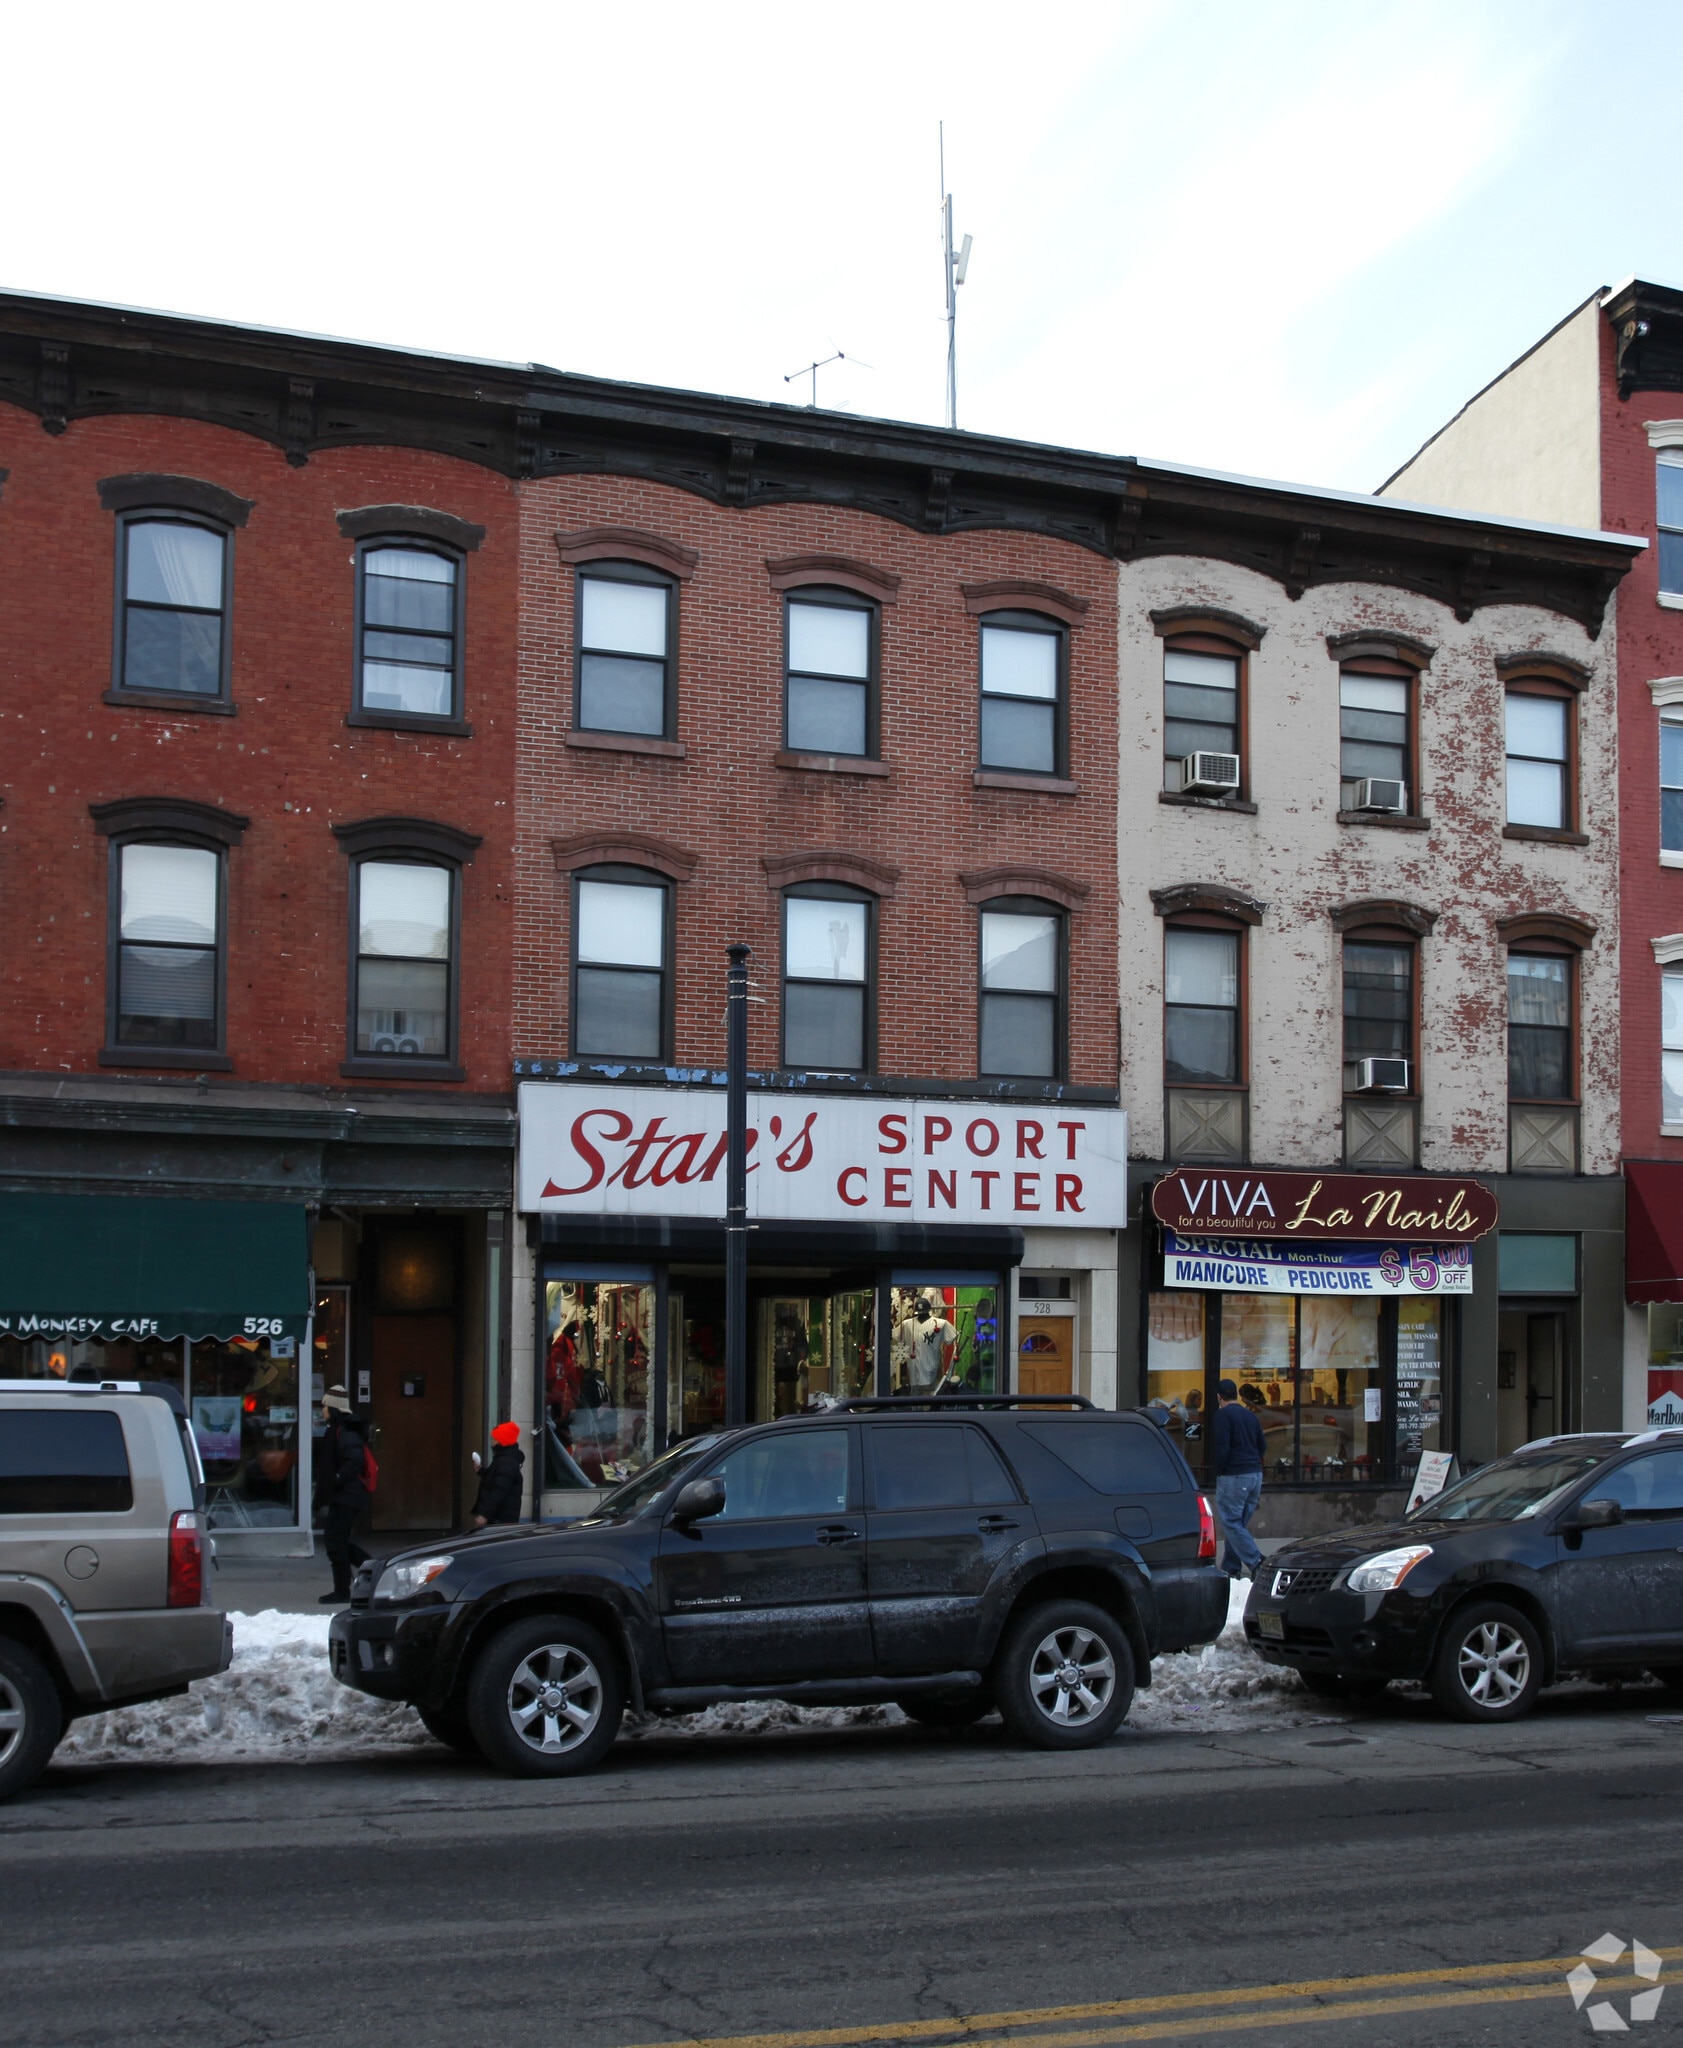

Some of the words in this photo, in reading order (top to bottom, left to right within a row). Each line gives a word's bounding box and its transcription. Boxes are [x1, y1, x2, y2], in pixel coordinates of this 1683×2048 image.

[877, 1113, 1086, 1160] SPORT
[540, 1107, 819, 1199] Stan's
[836, 1166, 1086, 1213] CENTER
[1179, 1178, 1276, 1217] VIVA
[1285, 1180, 1354, 1230] La
[1361, 1189, 1479, 1232] Nails
[1178, 1215, 1194, 1227] for
[1195, 1218, 1204, 1227] a
[1206, 1216, 1254, 1229] beautiful
[1255, 1219, 1276, 1230] you
[1174, 1235, 1282, 1262] SPECIAL
[1287, 1252, 1344, 1264] Mon-Thur
[1175, 1260, 1269, 1286] MANICURE
[1288, 1269, 1374, 1290] PEDICURE
[1444, 1273, 1467, 1284] OFF
[1034, 1302, 1051, 1314] 528
[18, 1314, 104, 1333] MONKEY
[110, 1318, 159, 1336] CAFE
[243, 1317, 284, 1335] 526
[1409, 1361, 1441, 1369] TREATMENT
[1398, 1381, 1421, 1389] ACRYLIC
[1397, 1400, 1419, 1408] WAXING
[1398, 1422, 1432, 1430] 201-792-3377
